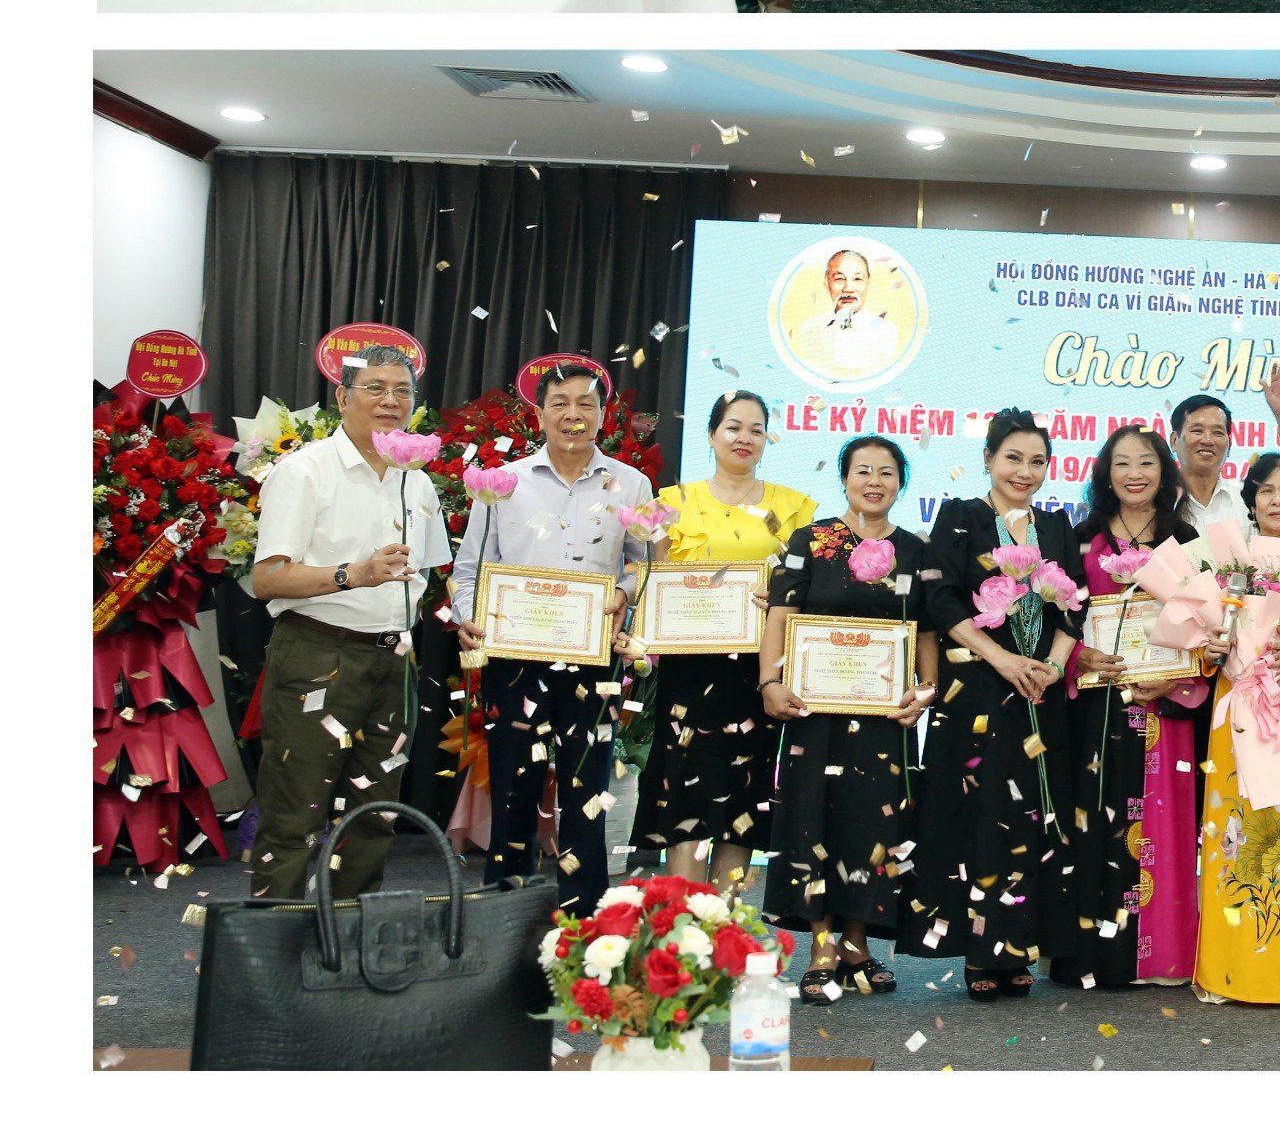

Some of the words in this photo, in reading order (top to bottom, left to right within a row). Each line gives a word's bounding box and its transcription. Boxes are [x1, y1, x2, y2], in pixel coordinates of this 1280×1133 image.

[996, 259, 1025, 282] HỘI
[1031, 259, 1078, 281] ĐỒNG
[1085, 265, 1144, 284] HƯƠNG
[1202, 271, 1226, 287] AN
[1244, 270, 1266, 289] HÀ
[1017, 289, 1049, 306] CLB
[1055, 288, 1091, 308] DÂN
[1097, 293, 1119, 310] CA
[1126, 292, 1141, 311] VÍ
[1199, 296, 1244, 318] NGHỆ
[1043, 330, 1184, 389] Chào
[830, 398, 868, 433] KỶ
[877, 404, 955, 441] NIỆM
[1046, 407, 1096, 441] ĂM
